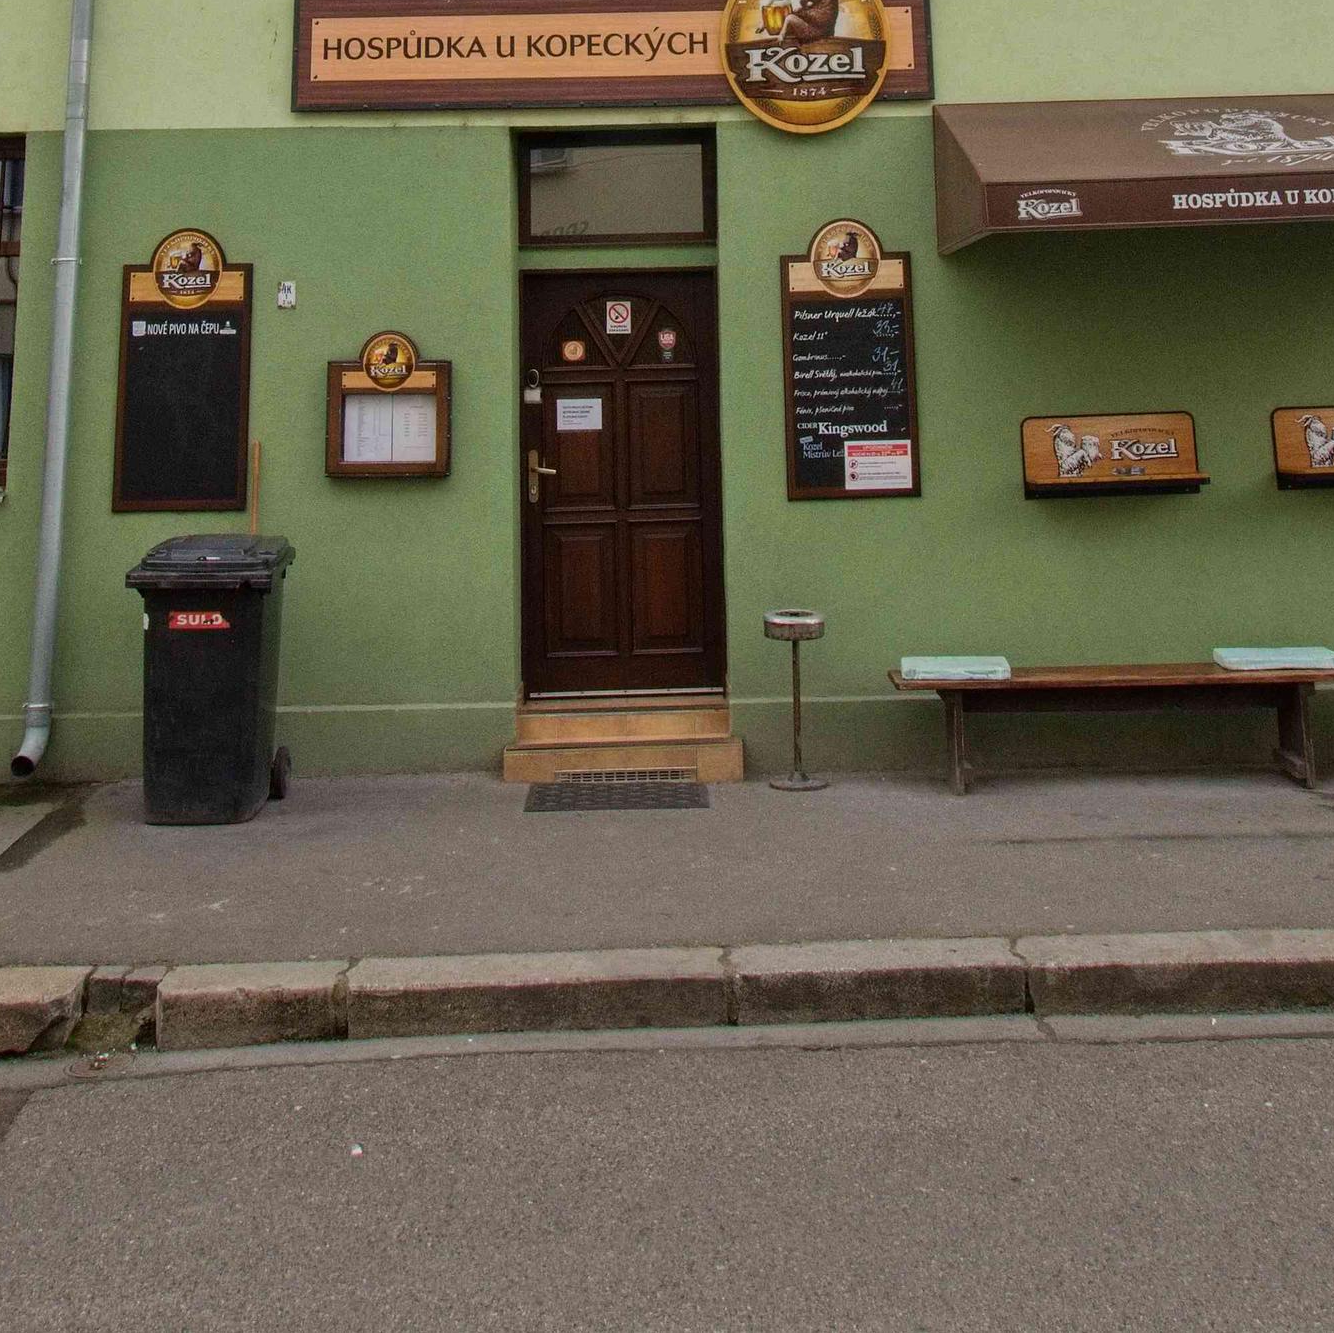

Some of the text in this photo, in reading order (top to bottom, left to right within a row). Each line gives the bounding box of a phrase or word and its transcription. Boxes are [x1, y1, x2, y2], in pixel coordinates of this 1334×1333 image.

[323, 26, 709, 62] HOSPŮDKA U KOPECKÝCH
[744, 46, 867, 84] Kozel
[792, 87, 827, 97] 1874
[1172, 187, 1283, 210] HOSPŮDKA
[1286, 190, 1300, 206] U
[1017, 198, 1083, 221] Kozel
[820, 261, 872, 278] Kozel
[162, 272, 212, 289] Kozel
[794, 309, 823, 320] Pilsner
[824, 308, 854, 323] Urquell
[147, 320, 220, 335] NOVÉ PIVO NA ČEPU
[793, 330, 817, 342] Kozel
[370, 364, 408, 378] Kozel
[818, 420, 887, 438] Kingswood
[803, 441, 823, 451] Kozel
[1108, 437, 1179, 462] Kozel
